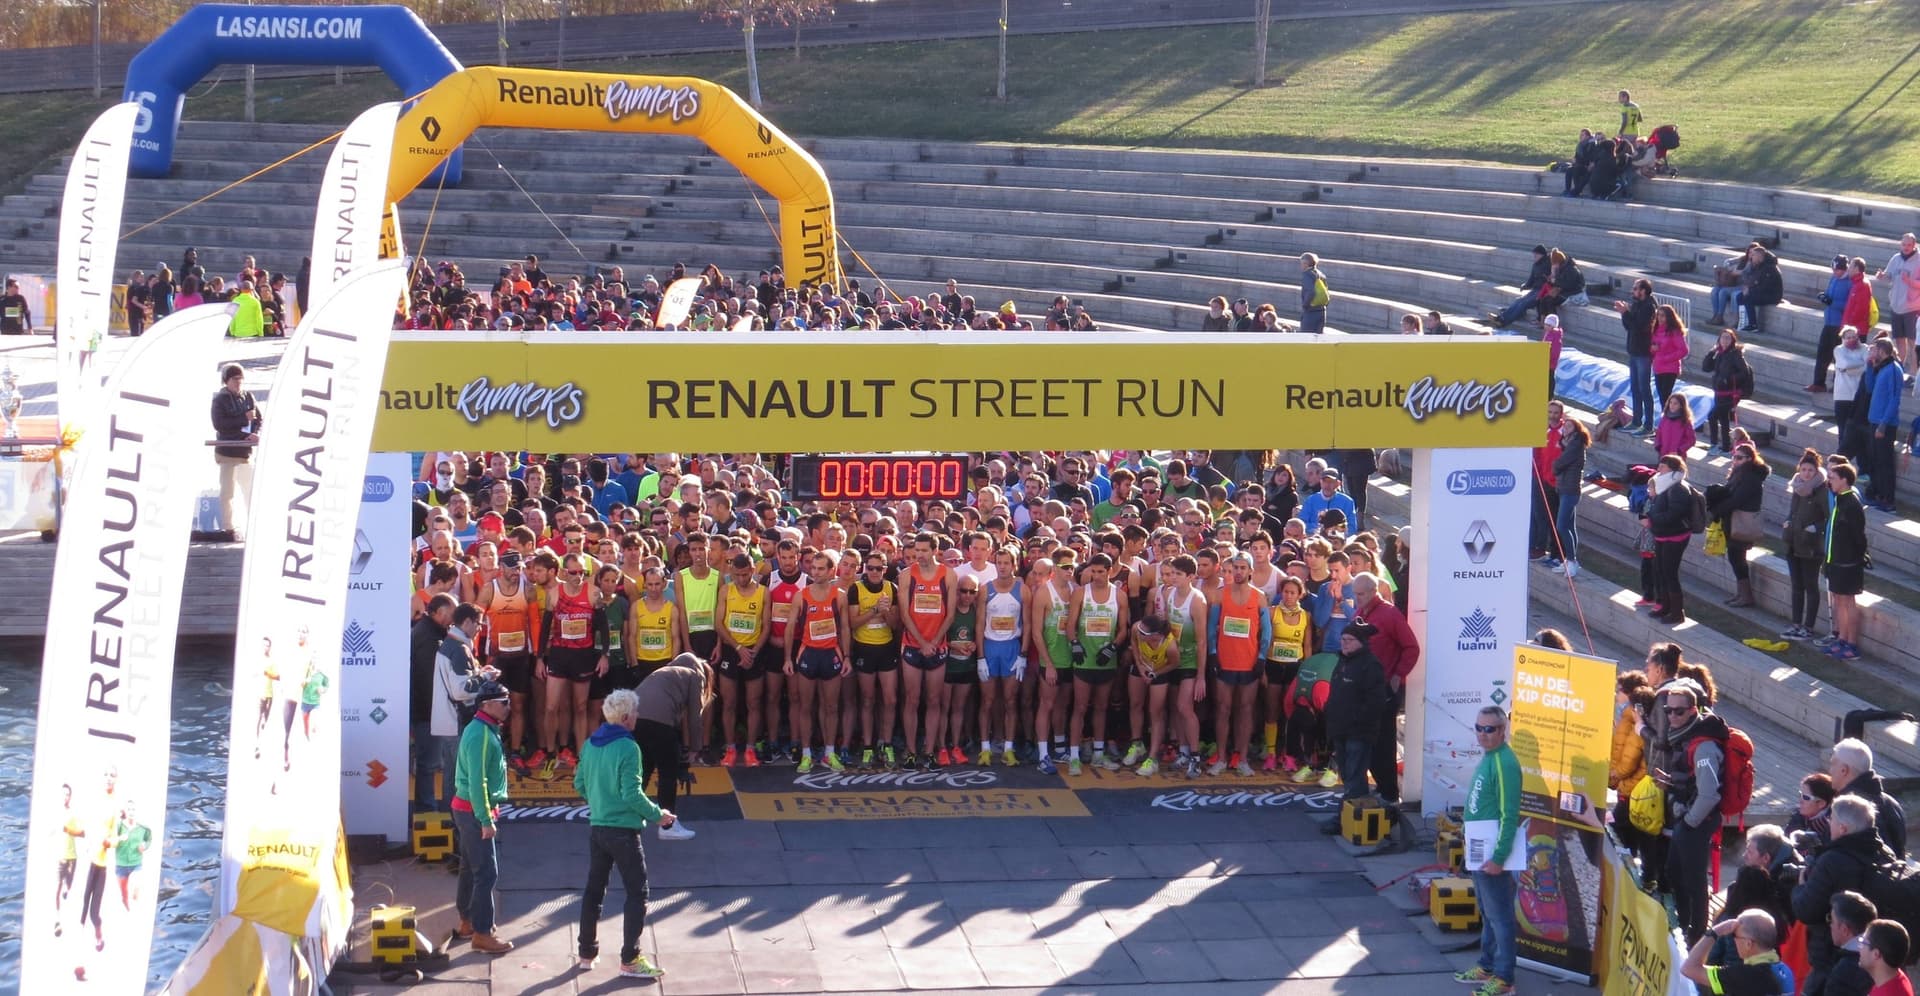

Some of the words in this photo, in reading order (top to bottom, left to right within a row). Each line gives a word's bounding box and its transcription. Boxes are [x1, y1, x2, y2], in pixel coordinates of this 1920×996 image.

[216, 16, 363, 40] LASANSI.COM
[408, 146, 448, 156] RENAULT
[747, 146, 787, 159] RENAULT
[77, 151, 102, 283] RENAULT
[333, 152, 360, 283] RENAULT
[801, 219, 828, 290] AULT
[379, 380, 459, 410] nault
[647, 379, 895, 419] RENAULT
[909, 378, 1102, 418] STREET
[1116, 379, 1226, 418] RUN
[281, 346, 335, 582] RENAULT
[820, 461, 960, 496] 00:00:00
[1471, 475, 1514, 489] LASANSI.COM
[85, 415, 144, 713] RENAULT
[1453, 570, 1505, 579] RENAULT
[347, 582, 383, 591] NAULT
[733, 619, 750, 628] 851
[643, 637, 662, 645] 490
[1457, 639, 1497, 651] luanvi
[1517, 671, 1544, 689] FAN
[1547, 676, 1575, 695] DEL
[1517, 687, 1539, 704] XIP
[1542, 692, 1585, 713] GROC!
[794, 793, 1025, 807] RENAULT
